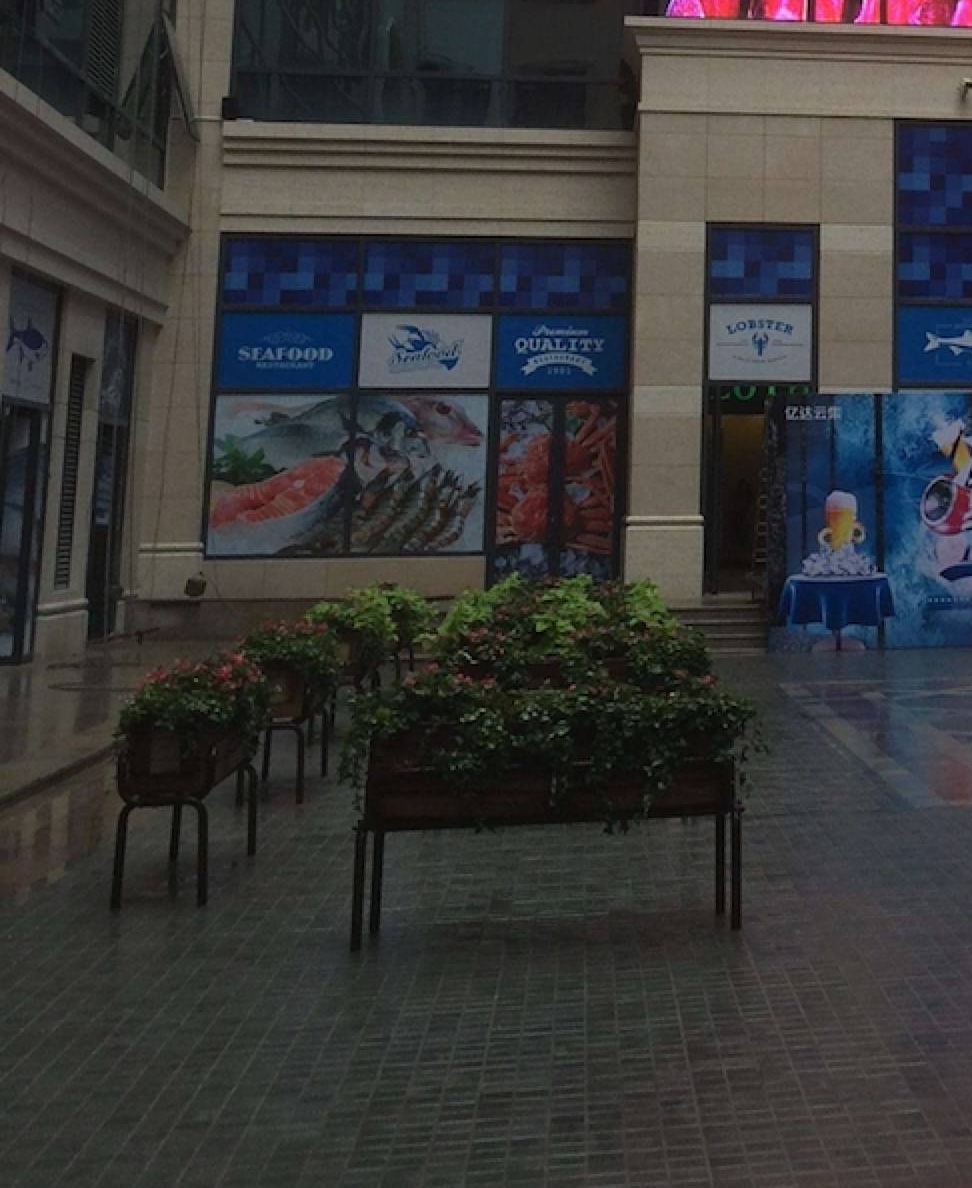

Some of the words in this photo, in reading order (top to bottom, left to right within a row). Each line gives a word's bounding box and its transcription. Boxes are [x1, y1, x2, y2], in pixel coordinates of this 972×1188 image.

[726, 319, 794, 335] LOBSTER
[237, 345, 334, 362] SEAFOOD
[514, 336, 606, 355] QUALITY
